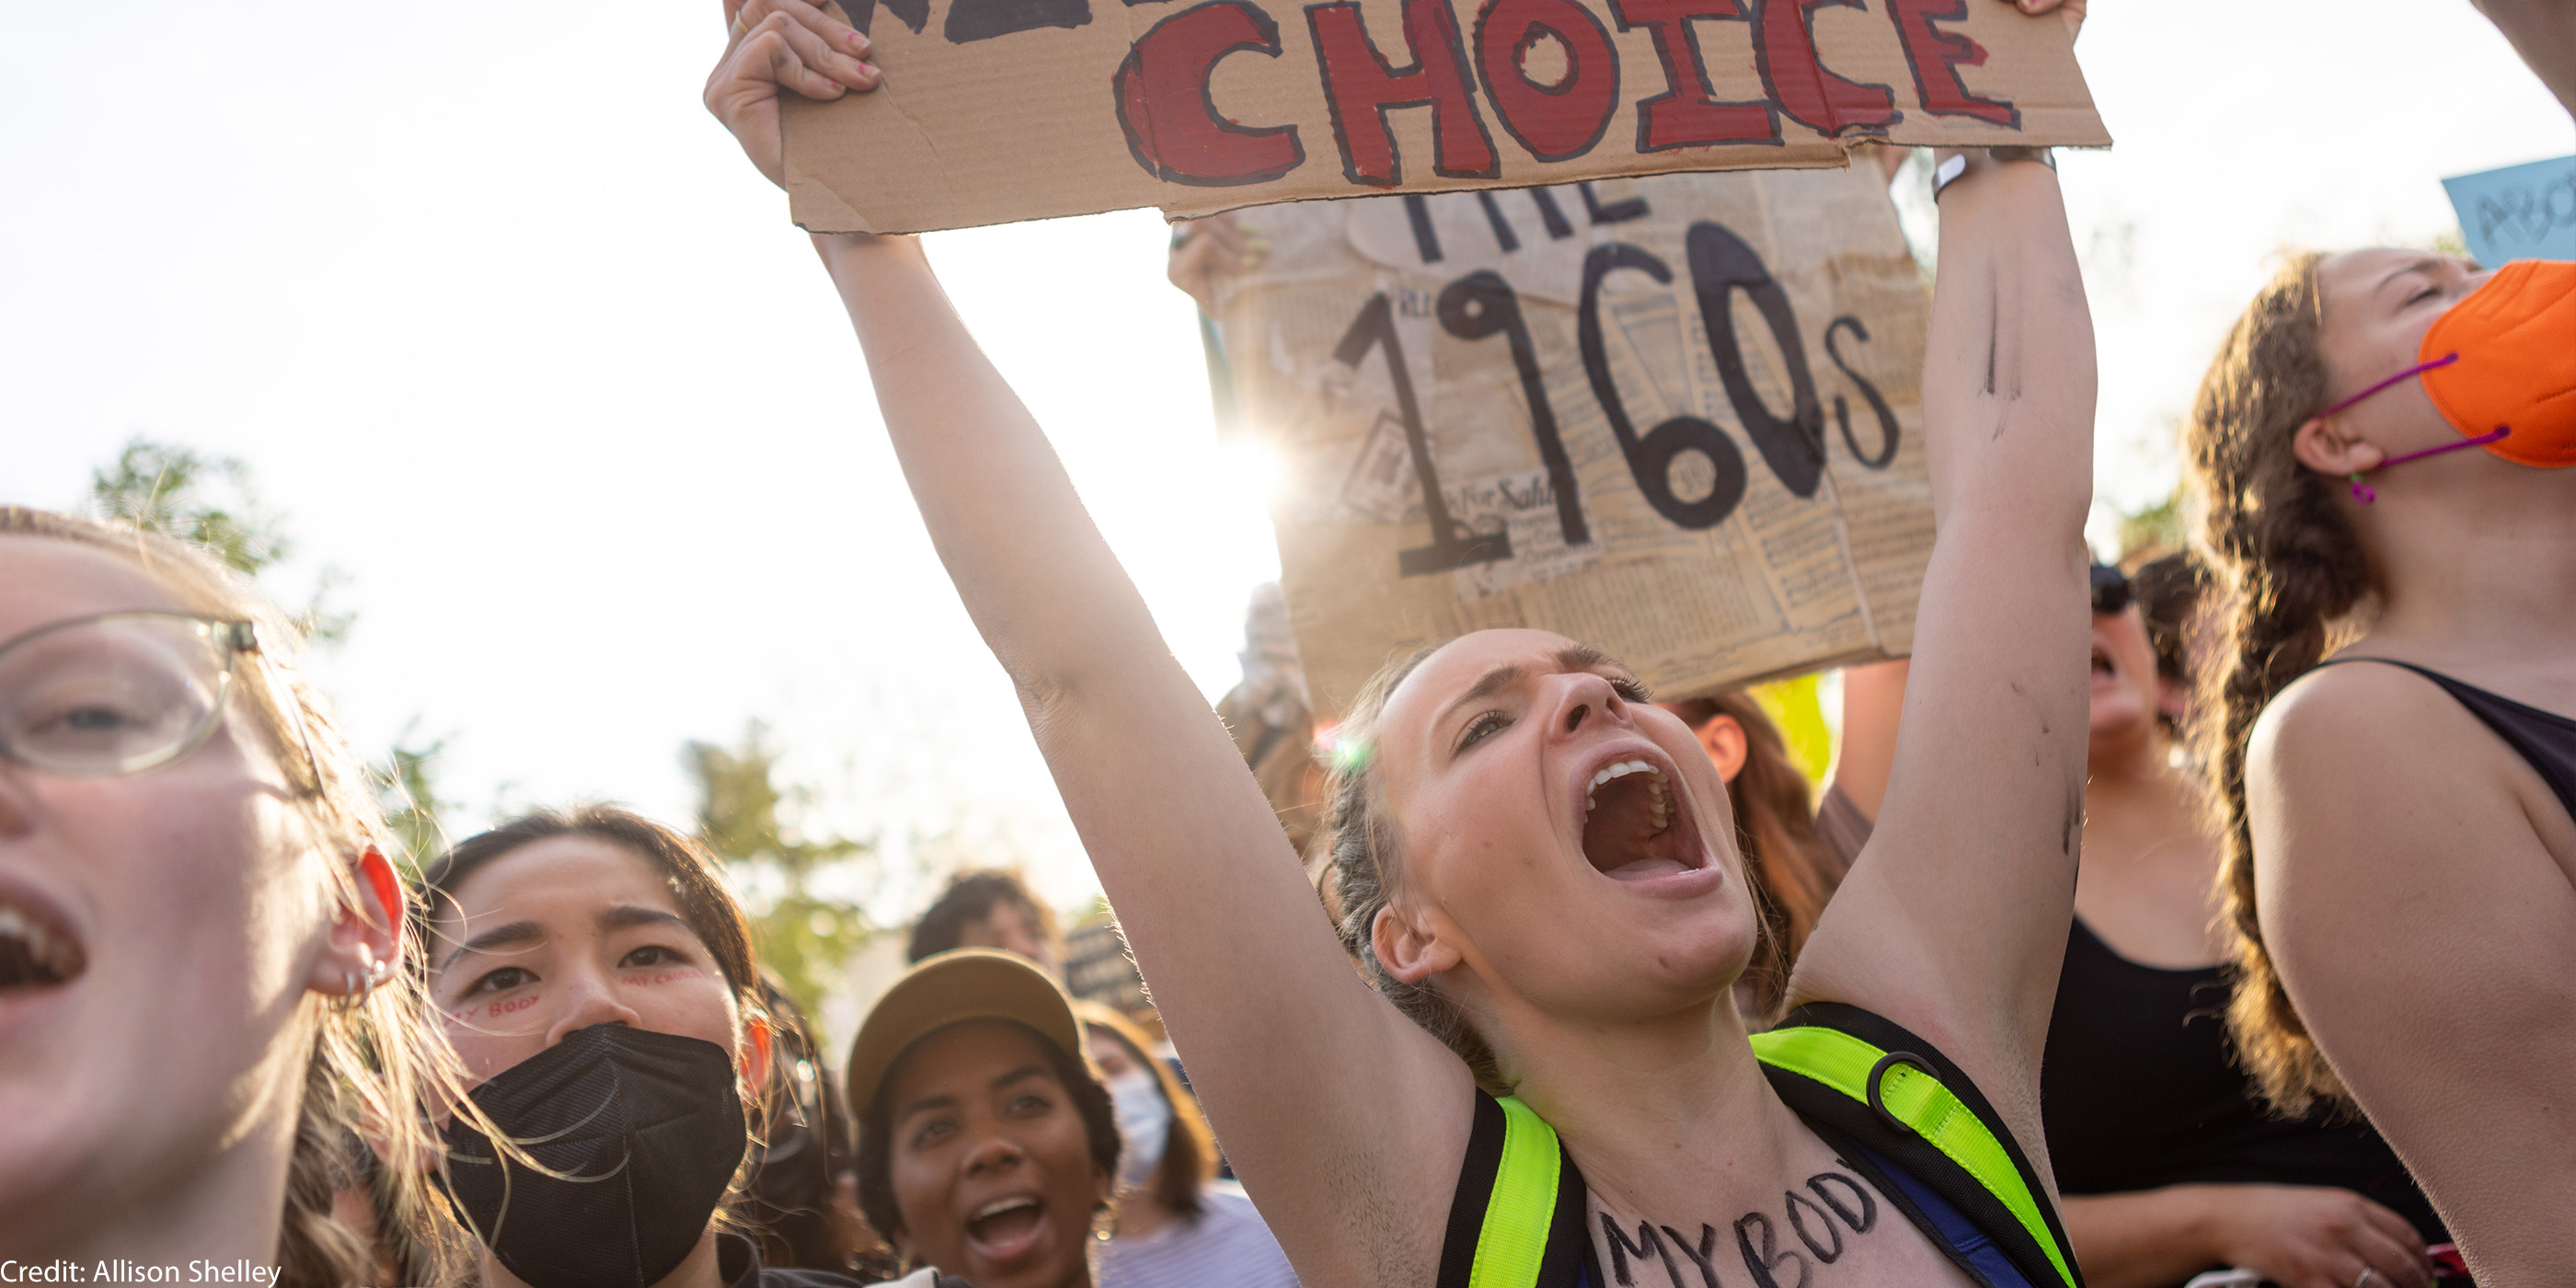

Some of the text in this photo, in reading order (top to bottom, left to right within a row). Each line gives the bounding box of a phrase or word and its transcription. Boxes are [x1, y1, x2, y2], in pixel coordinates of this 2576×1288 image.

[1111, 0, 2021, 189] CHOICE
[2475, 173, 2576, 258] ABO
[489, 994, 541, 1018] BODY
[1598, 1157, 1878, 1288] MY BOD
